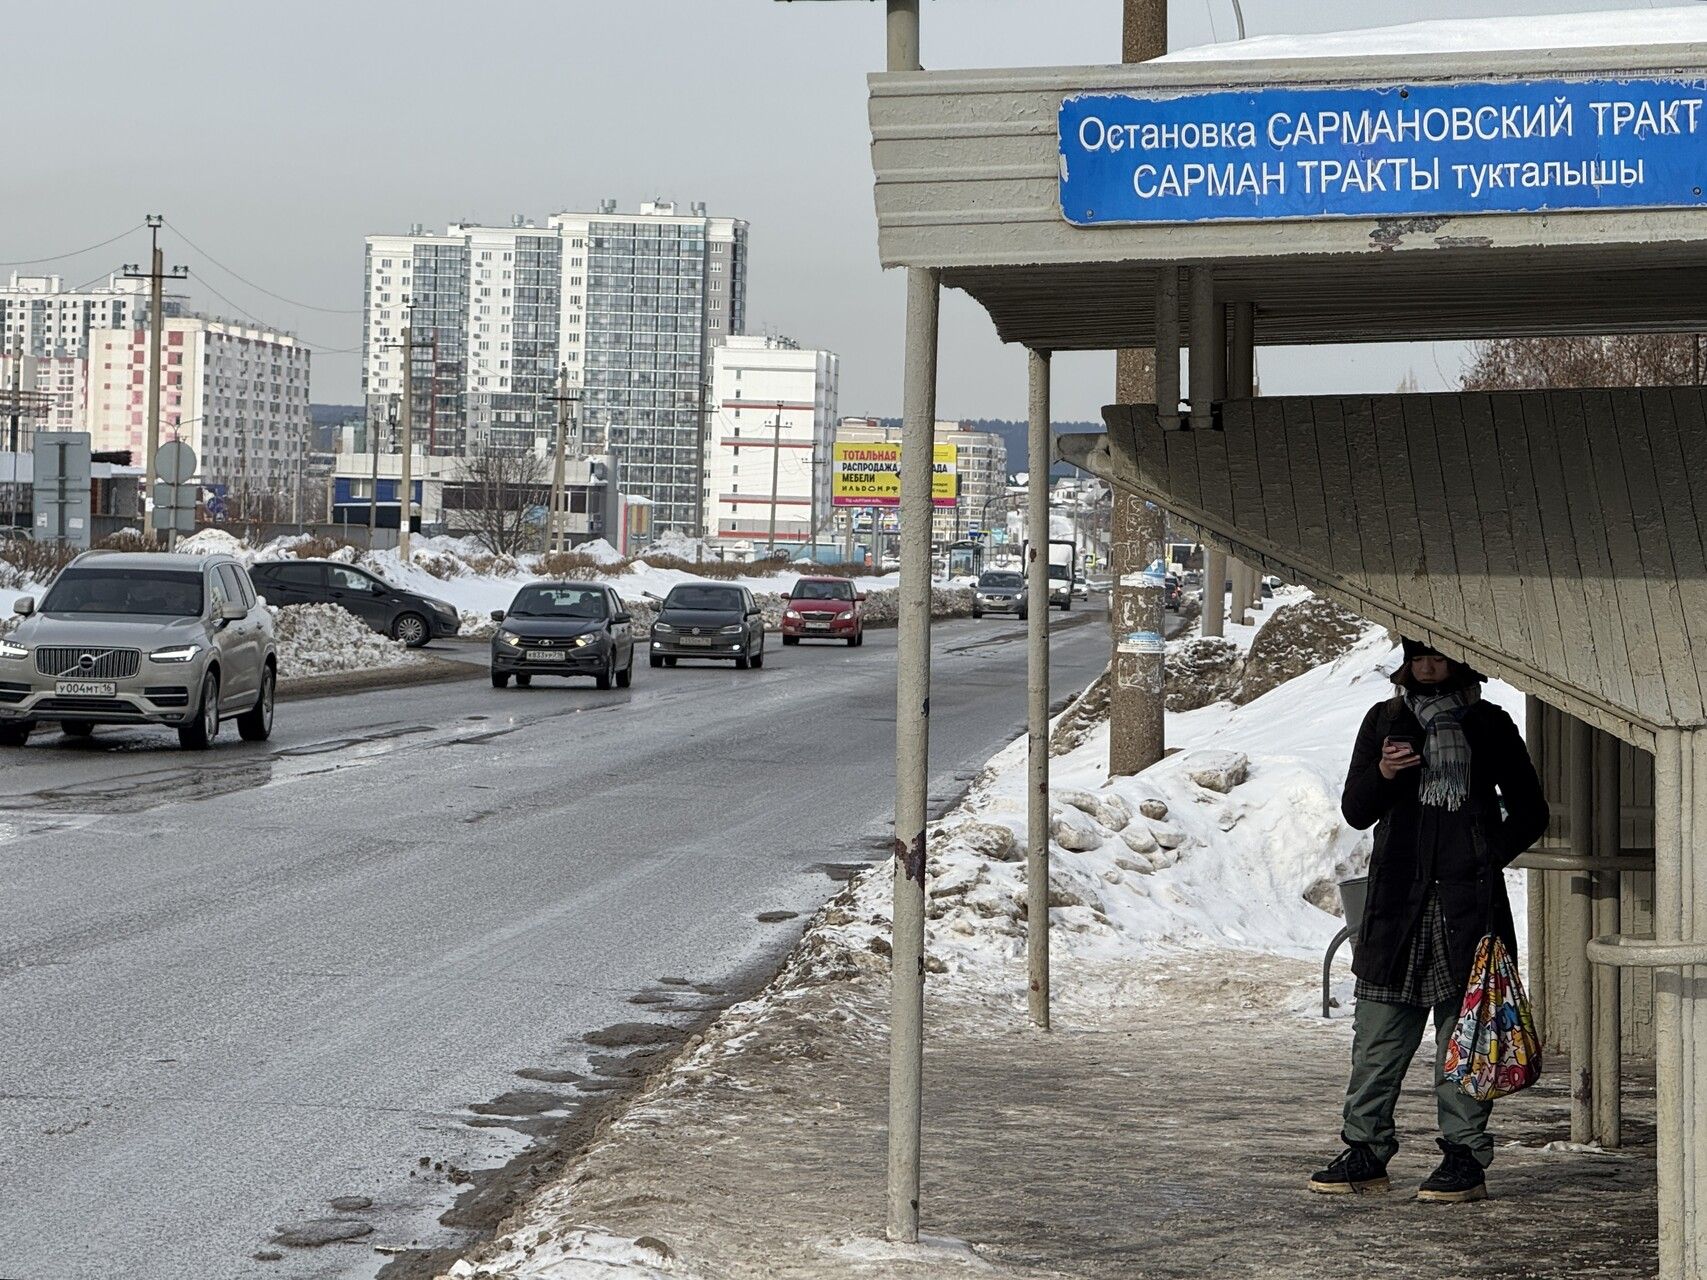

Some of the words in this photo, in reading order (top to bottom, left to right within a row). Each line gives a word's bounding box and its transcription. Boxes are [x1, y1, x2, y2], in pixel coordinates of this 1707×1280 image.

[1078, 116, 1256, 152] Остановка
[1267, 96, 1574, 147] САРМАНОВСКИЙ
[1589, 98, 1703, 136] ТРАКТ
[1133, 161, 1285, 199] САРМАН
[1298, 155, 1440, 193] ТРАКТЫ
[1452, 159, 1645, 198] тукталышы
[842, 449, 897, 461] ТОТАЛЬНАЯ
[842, 462, 898, 472] РАСПРОДАЖА
[842, 473, 875, 482] МЕБЕЛИ
[60, 683, 99, 694] У004МТ
